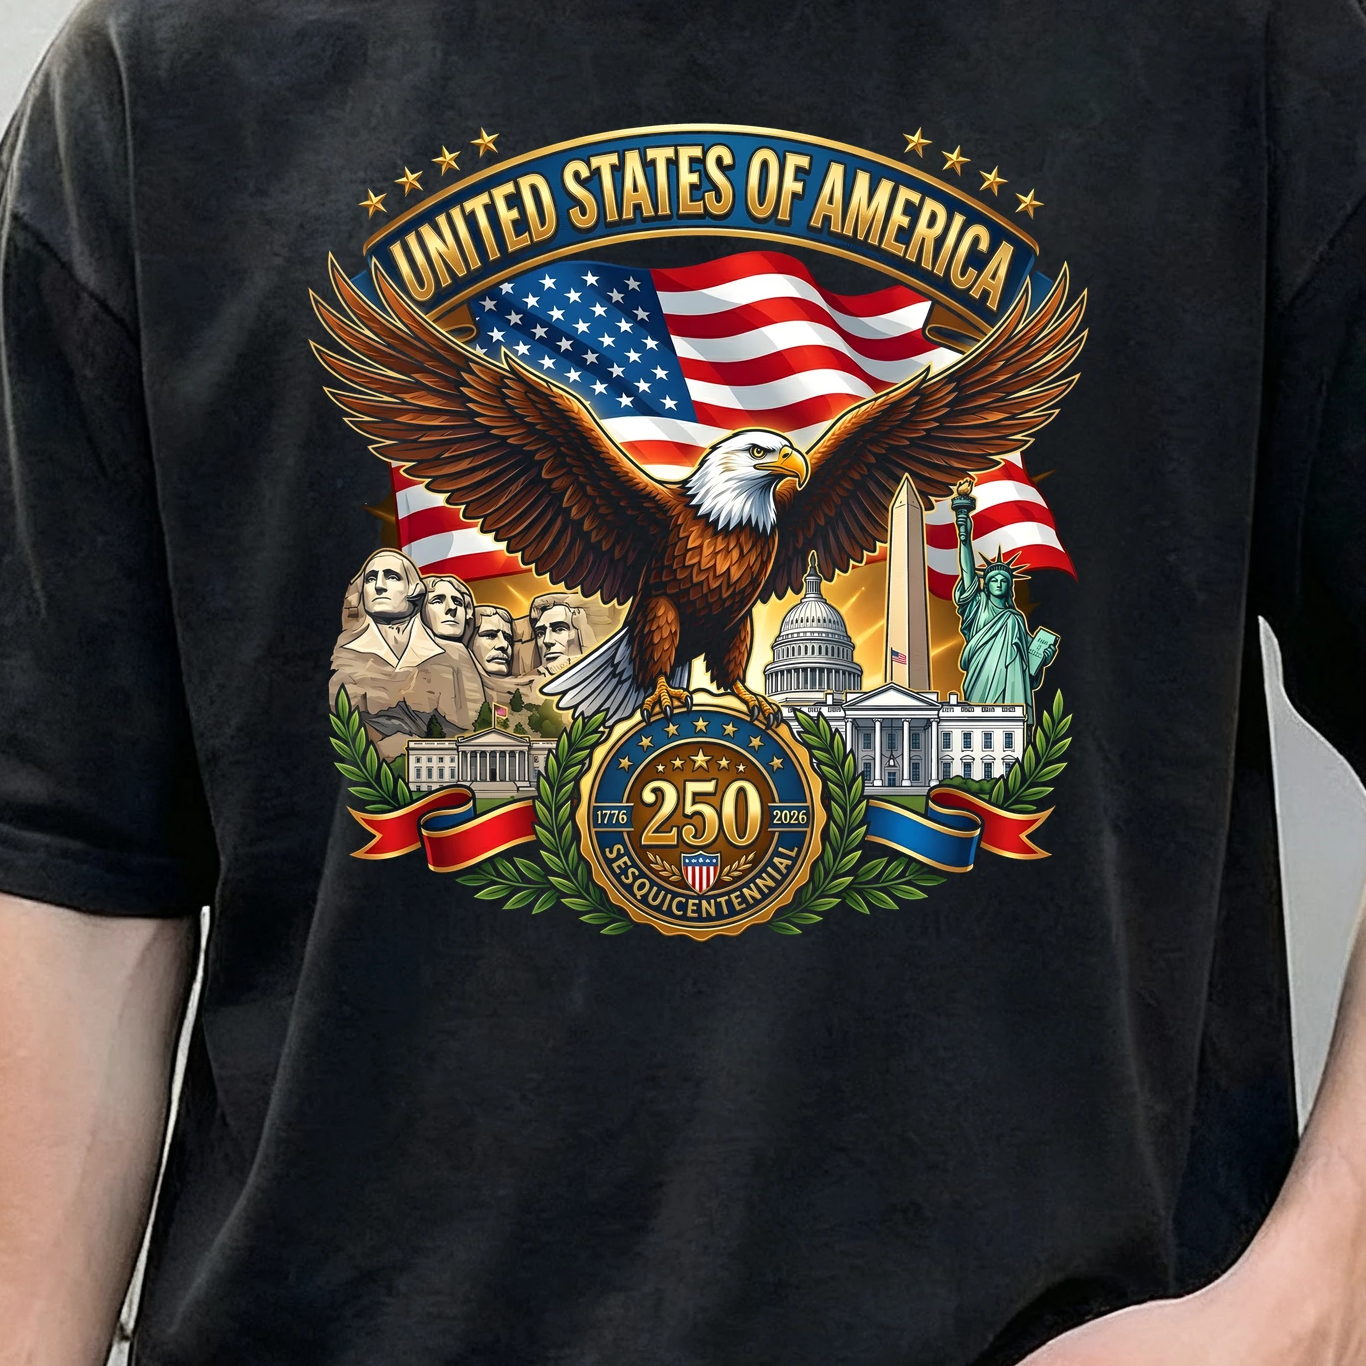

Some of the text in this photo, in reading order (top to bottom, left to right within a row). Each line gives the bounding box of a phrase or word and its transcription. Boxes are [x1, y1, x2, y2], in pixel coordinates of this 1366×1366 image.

[390, 145, 1014, 312] UNITED STATES OF AMERICA
[596, 809, 628, 825] 1776
[641, 778, 762, 846] 250
[772, 809, 807, 824] 2026
[605, 844, 798, 918] SESQUICENTENNIAL
